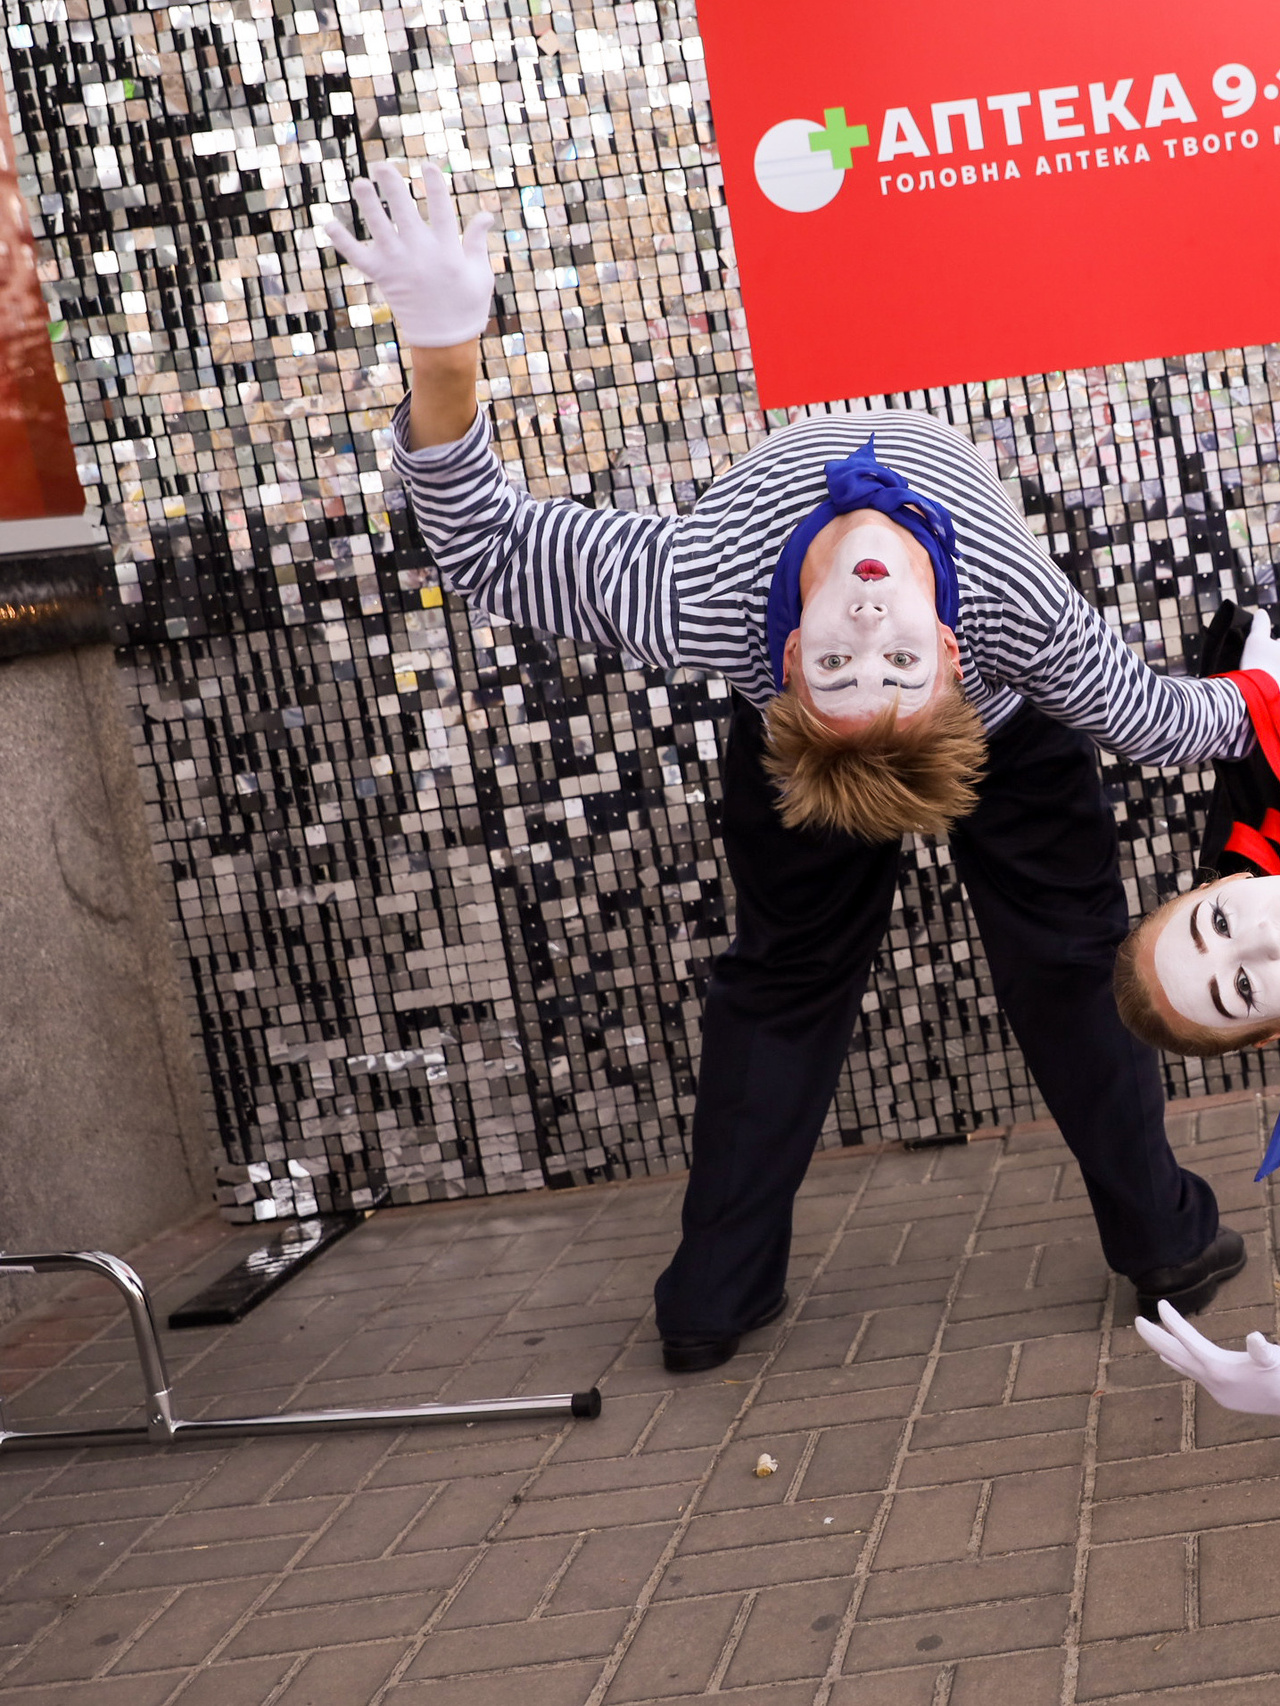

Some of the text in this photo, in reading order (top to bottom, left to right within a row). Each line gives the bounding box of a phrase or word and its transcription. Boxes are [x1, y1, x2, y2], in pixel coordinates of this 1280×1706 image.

[877, 72, 1198, 163] АПТЕКА
[880, 159, 1021, 196] ГОЛОВНА
[1035, 143, 1151, 176] АПТЕКА
[1162, 128, 1259, 159] ТВОГО
